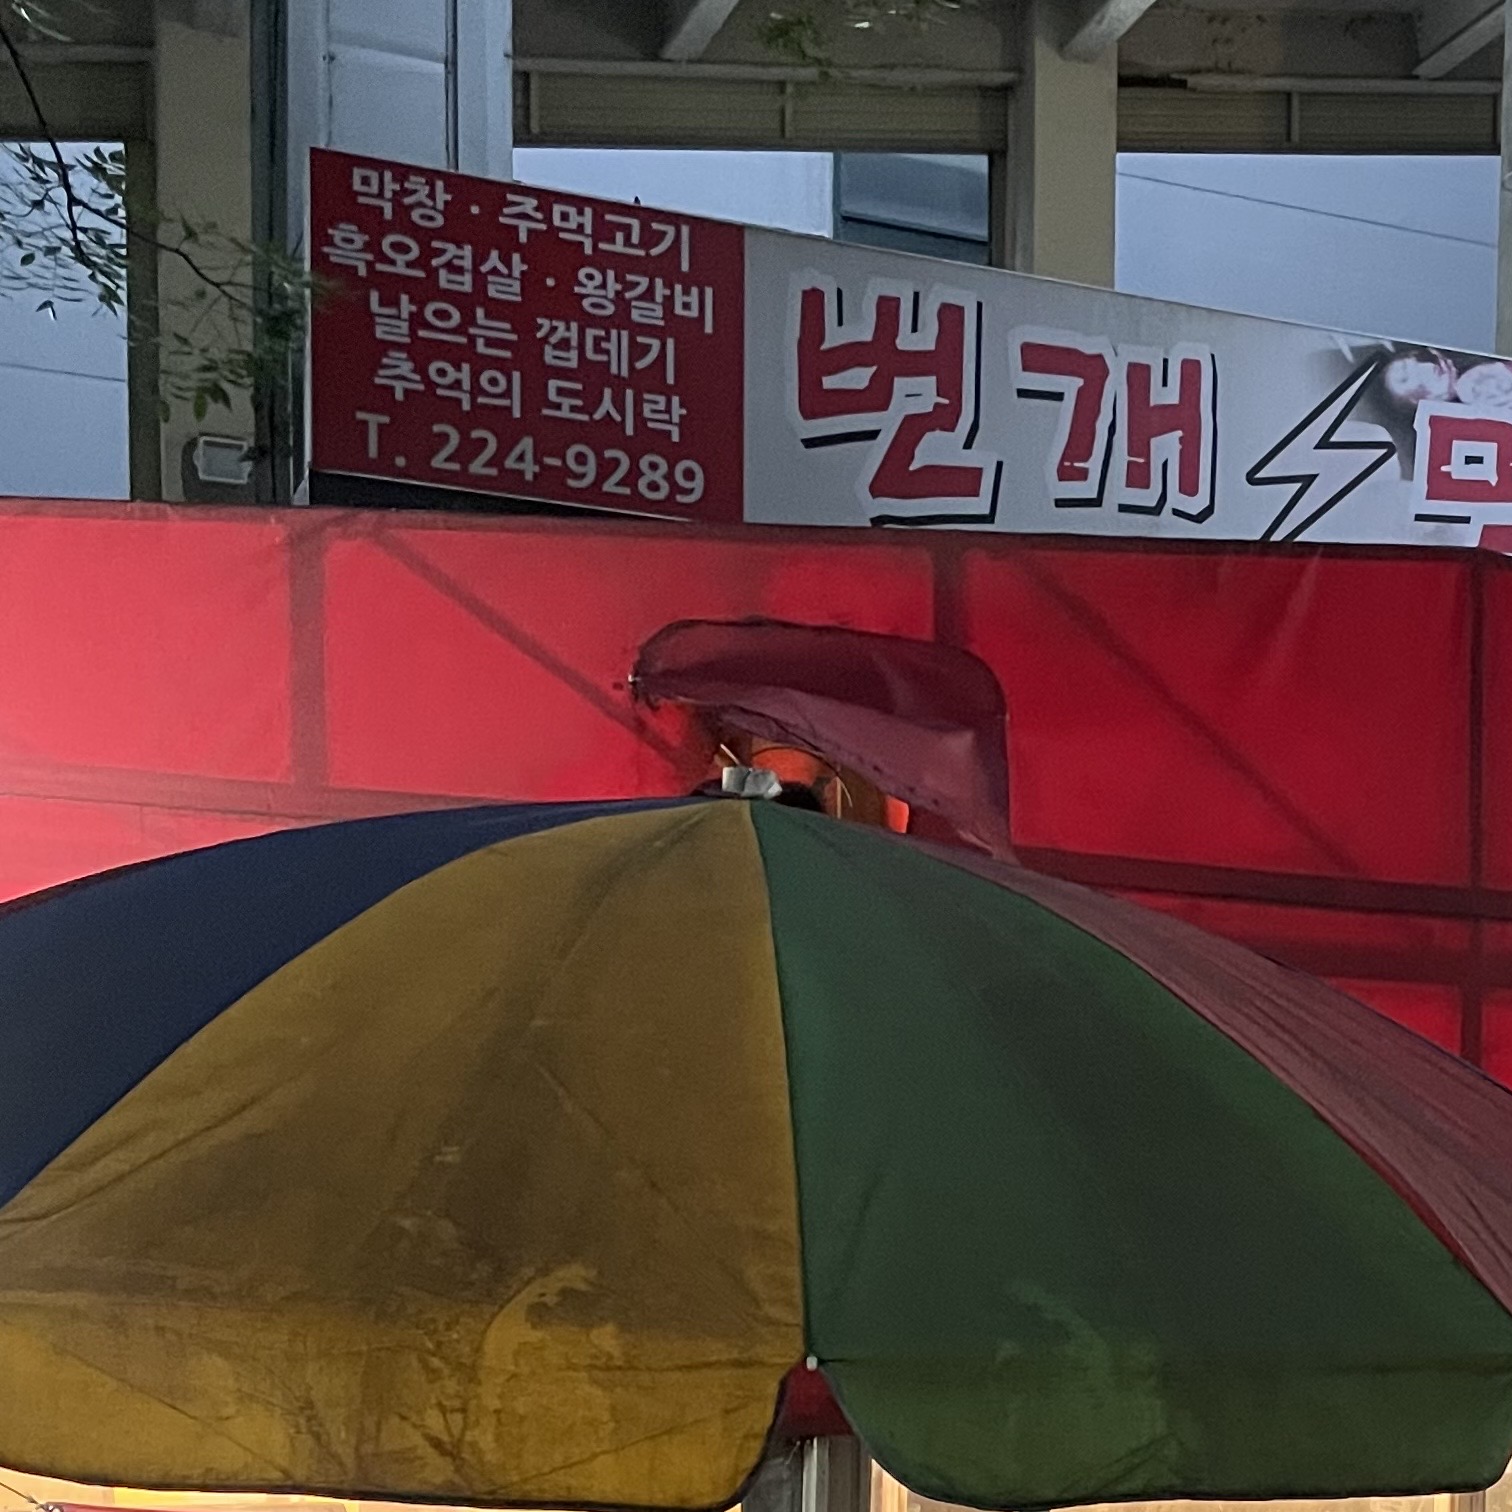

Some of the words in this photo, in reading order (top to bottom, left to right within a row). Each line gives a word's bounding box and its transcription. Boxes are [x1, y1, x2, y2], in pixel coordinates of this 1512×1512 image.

[352, 166, 452, 228] 막창
[499, 193, 690, 272] 주먹고기
[322, 224, 528, 302] 흑오겹살
[574, 267, 714, 334] 왕갈비
[369, 289, 518, 358] 날으는
[536, 317, 675, 385] 껍데기
[374, 352, 521, 418] 추억의
[541, 379, 686, 442] 도시락
[355, 411, 407, 468] T.
[430, 424, 705, 503] 224-9289
